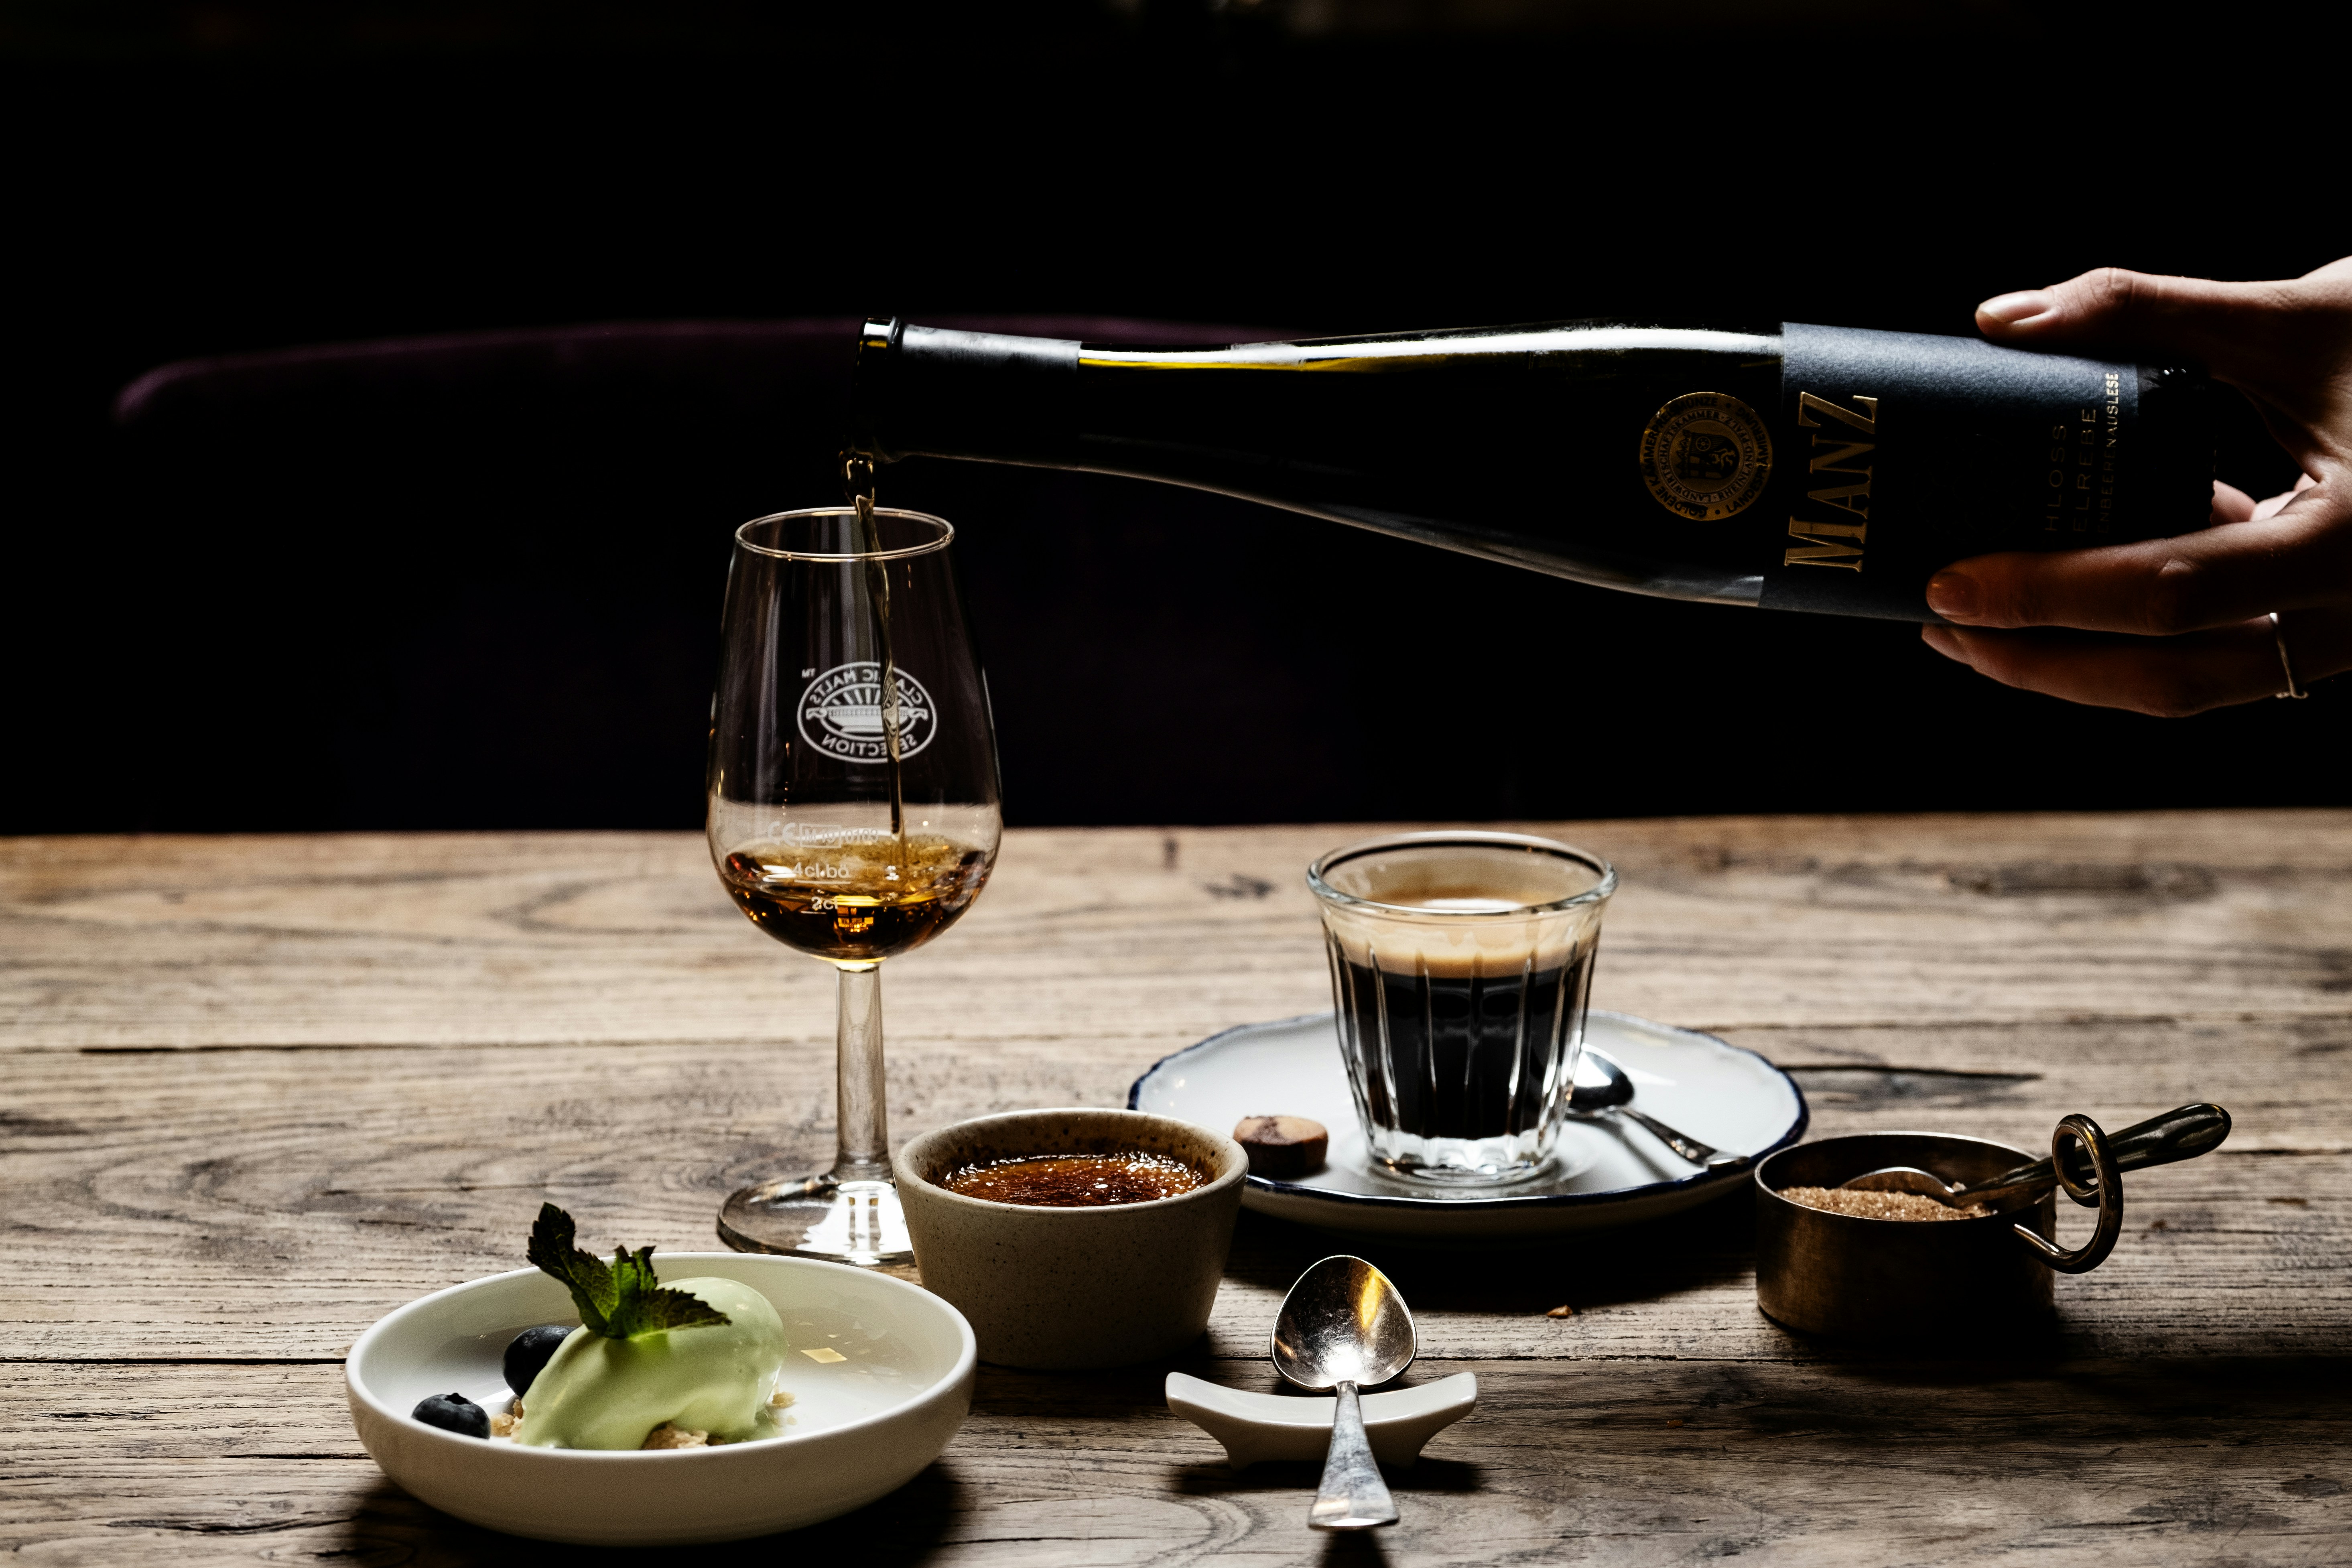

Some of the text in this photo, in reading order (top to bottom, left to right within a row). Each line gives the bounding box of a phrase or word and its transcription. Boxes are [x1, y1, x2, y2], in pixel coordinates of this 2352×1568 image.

[1659, 410, 1719, 502] LANDWIRTSCHAFTSKAMMER
[1784, 391, 1879, 573] MANZ
[2097, 373, 2119, 545] ENBEERENAUSLESE
